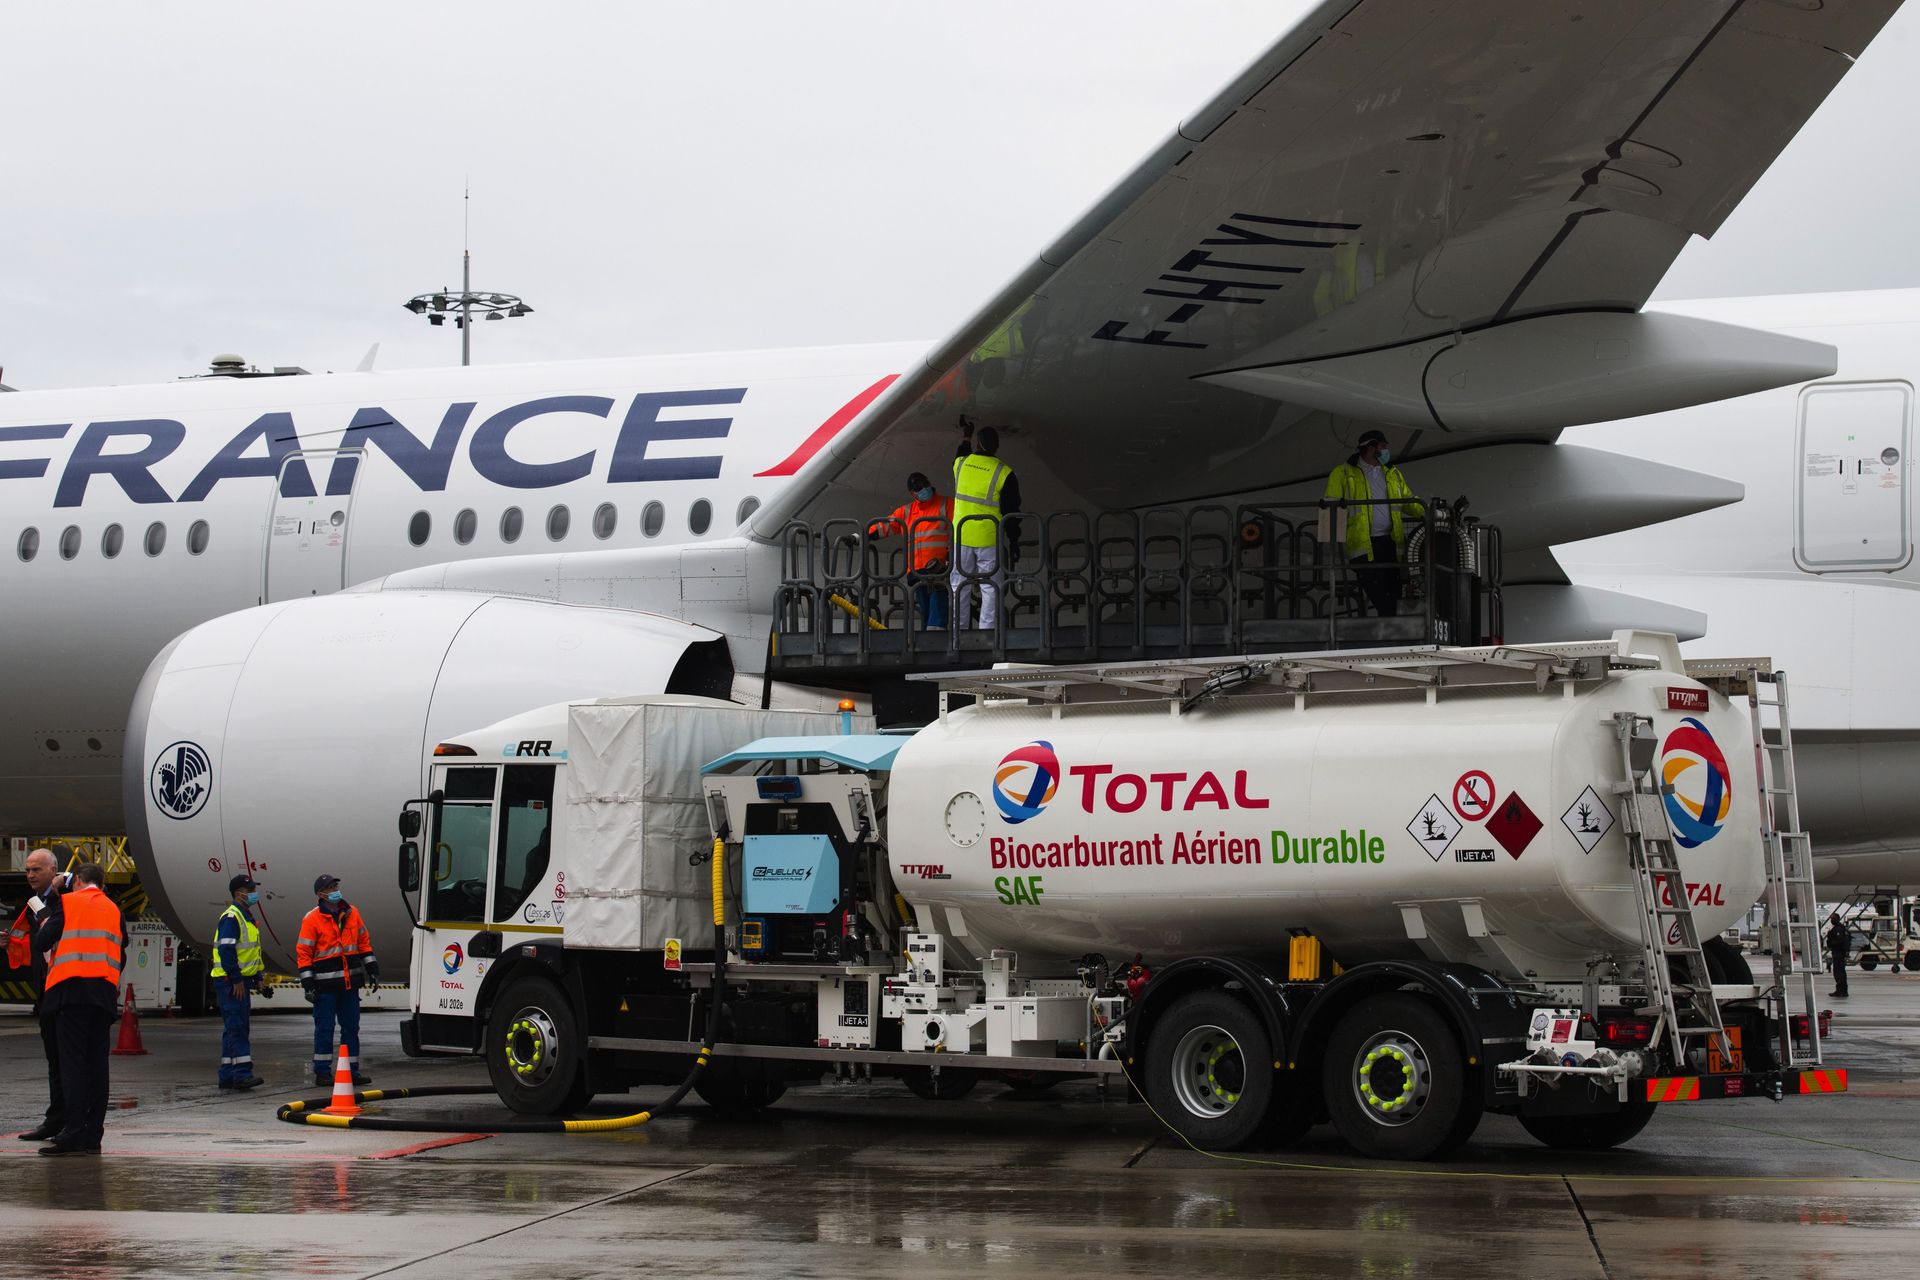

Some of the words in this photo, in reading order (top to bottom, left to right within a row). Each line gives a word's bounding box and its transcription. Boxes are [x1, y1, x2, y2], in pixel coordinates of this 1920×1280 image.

[1091, 213, 1362, 349] F-HTYI
[1669, 691, 1699, 706] TITAN
[502, 740, 553, 757] eRR
[1069, 764, 1270, 814] TOTAL
[990, 833, 1164, 869] Biocarburant
[1171, 830, 1262, 865] Aérien
[1271, 829, 1385, 864] Durable
[1463, 851, 1480, 861] JET
[1480, 851, 1494, 860] A-1
[899, 864, 944, 879] TITAN
[993, 875, 1044, 906] SAF
[440, 980, 464, 990] TOTAL
[439, 998, 448, 1008] AU
[449, 999, 463, 1009] 202e
[844, 1017, 857, 1025] JET
